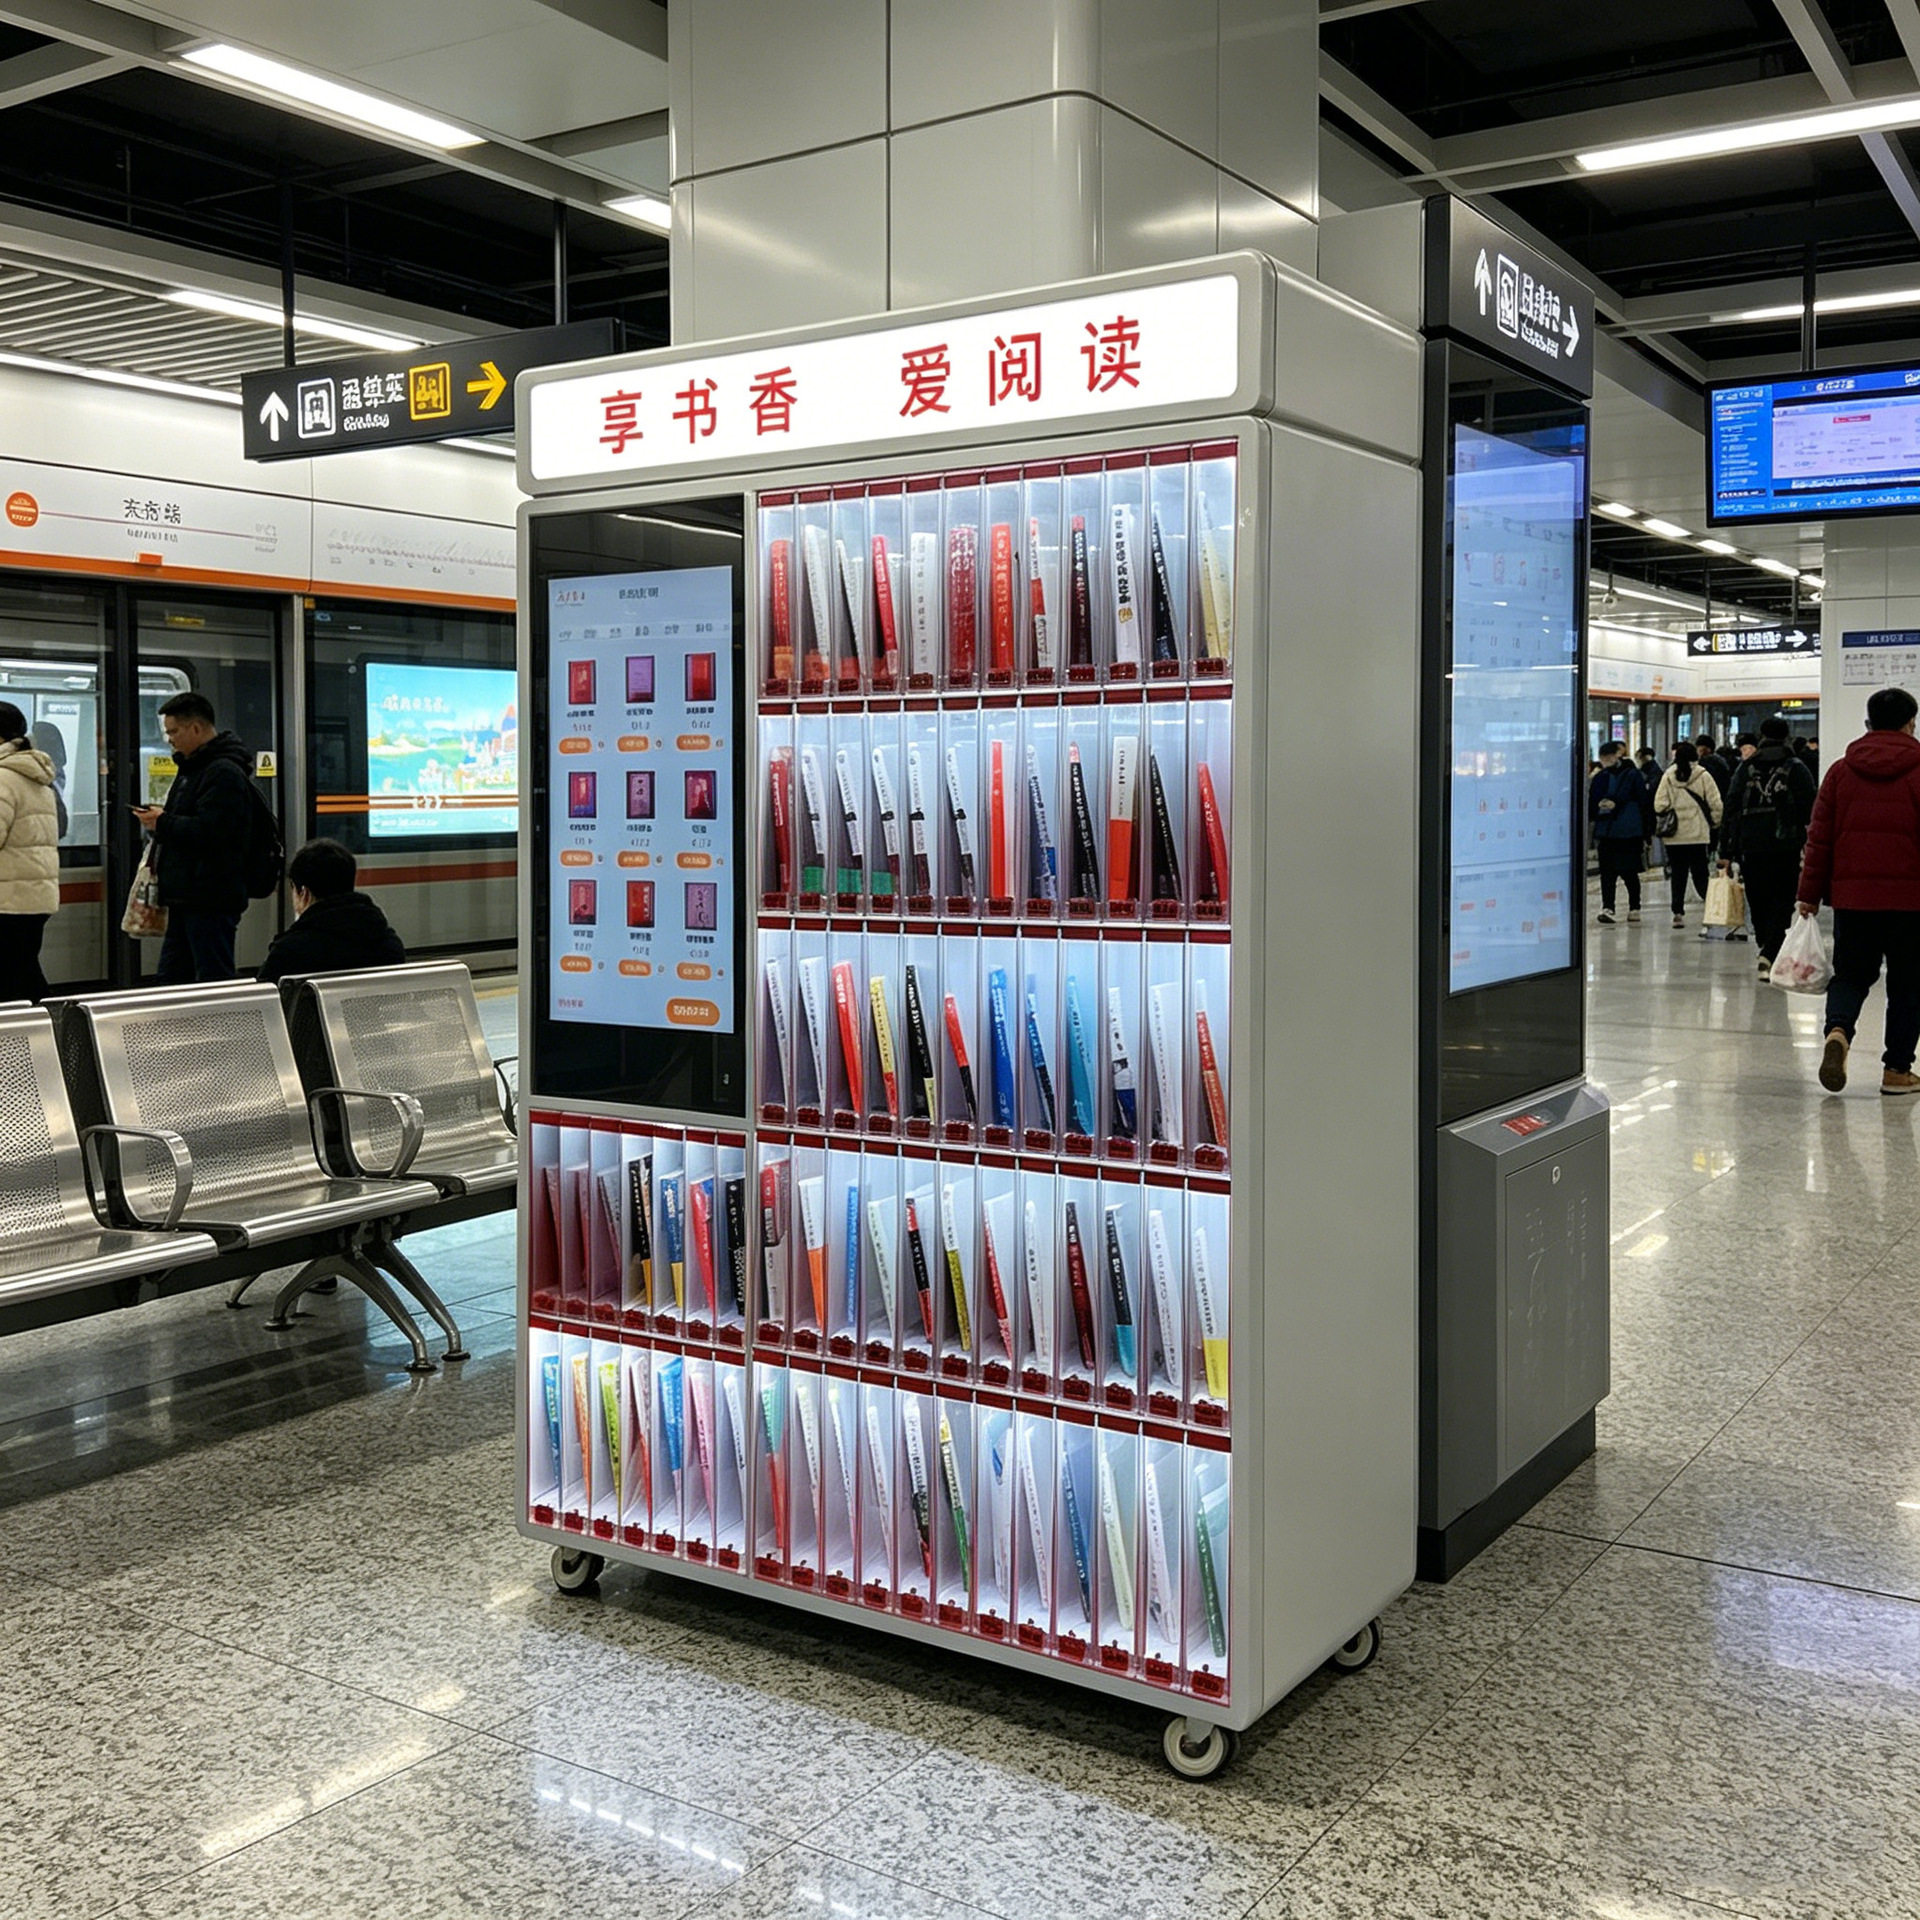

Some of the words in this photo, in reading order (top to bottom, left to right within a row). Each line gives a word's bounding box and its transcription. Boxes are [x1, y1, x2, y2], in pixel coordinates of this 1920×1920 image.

[599, 366, 798, 455] 享书香
[899, 314, 1141, 417] 爱阅读
